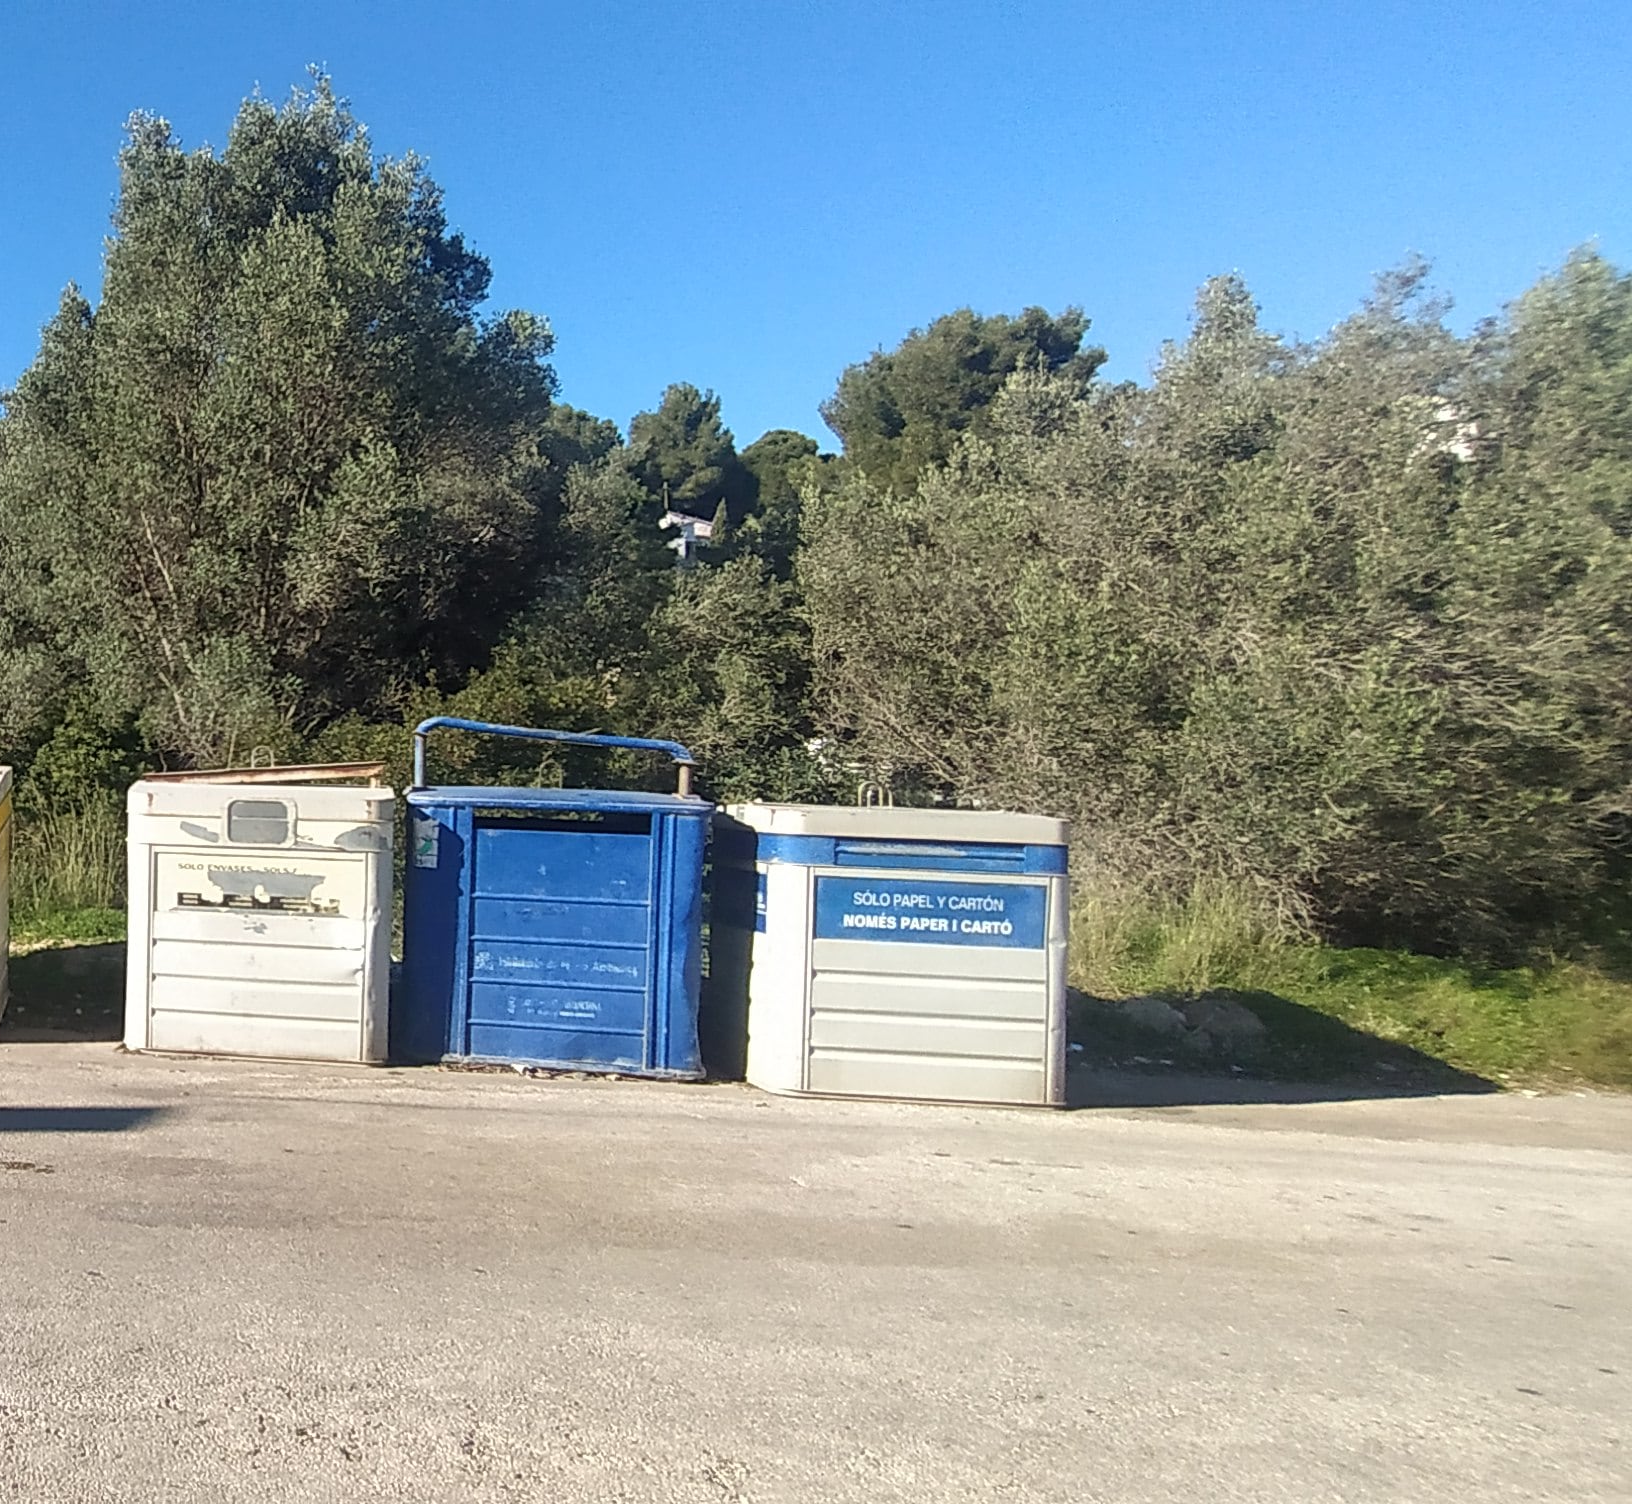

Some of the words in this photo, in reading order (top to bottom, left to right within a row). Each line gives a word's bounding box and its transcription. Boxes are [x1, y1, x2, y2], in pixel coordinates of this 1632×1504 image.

[853, 889, 891, 907] SÓLO
[893, 893, 934, 909] PAPEL
[937, 896, 947, 908] Y
[948, 895, 1004, 912] CARTÓN
[843, 912, 897, 930] NOMÉS
[900, 917, 949, 932] PAPER
[952, 919, 958, 932] I
[960, 918, 1013, 935] CARTÓ
